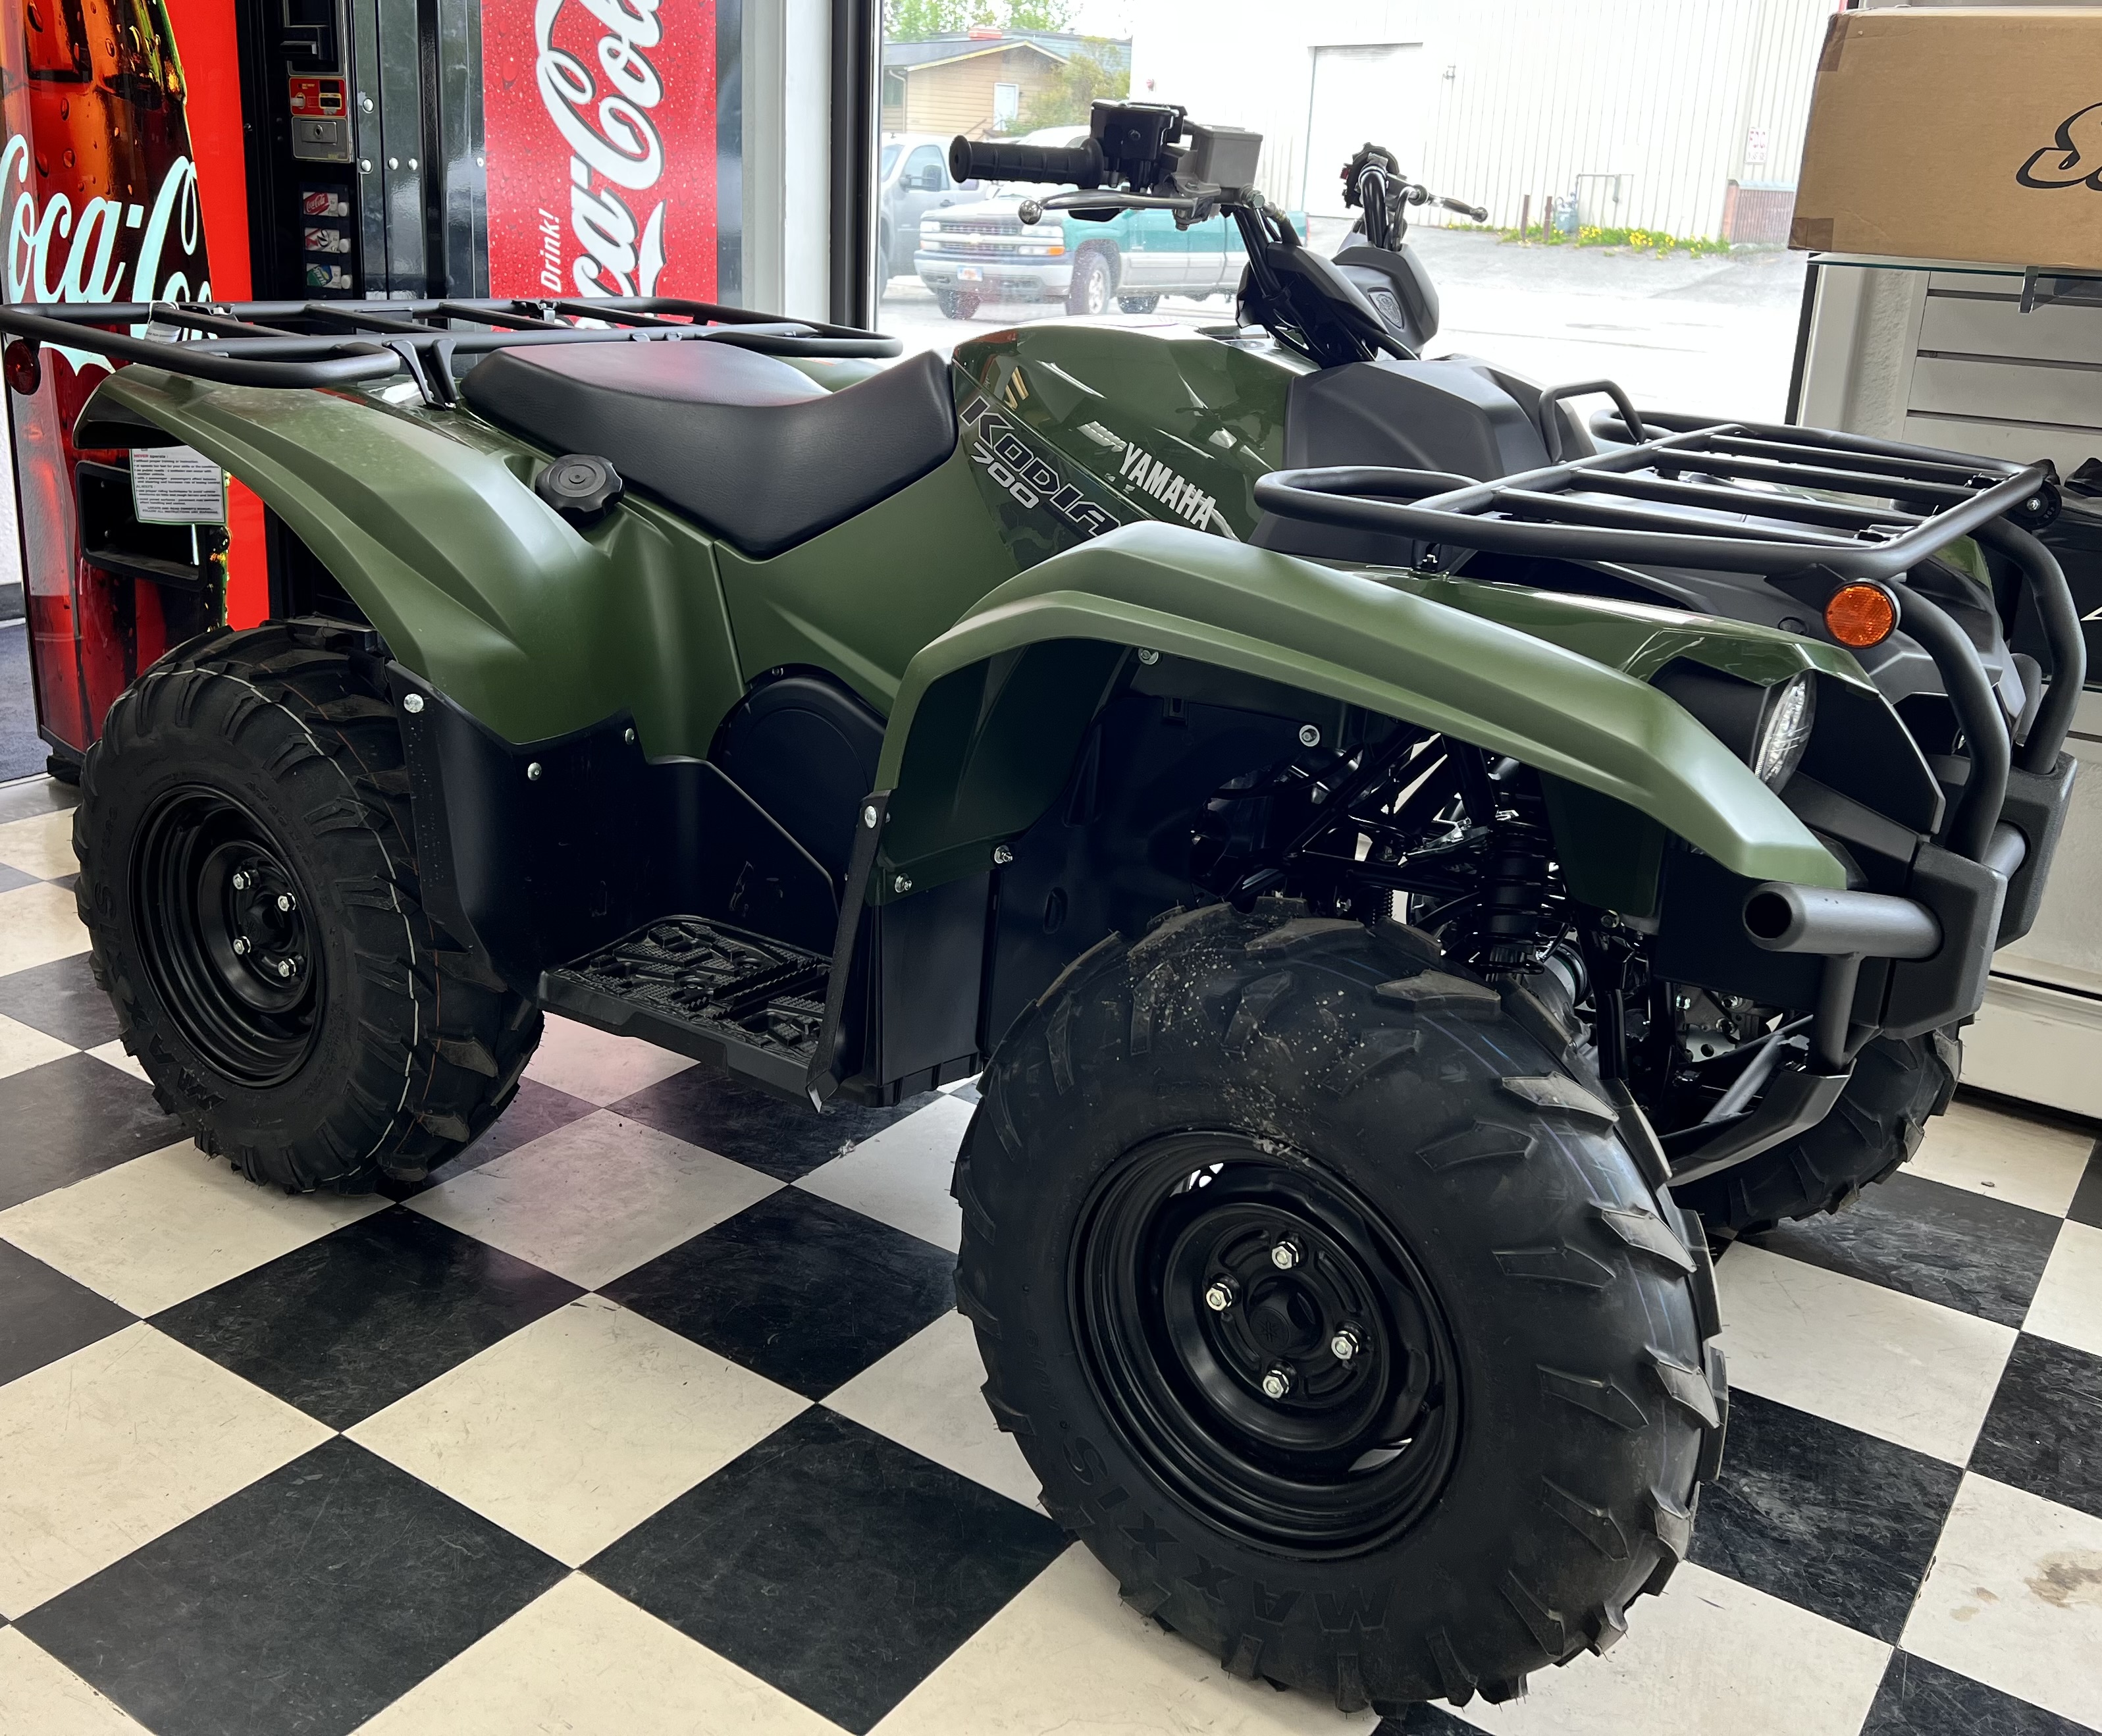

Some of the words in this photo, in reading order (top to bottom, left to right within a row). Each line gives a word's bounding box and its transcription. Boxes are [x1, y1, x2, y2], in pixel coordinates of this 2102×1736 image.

[539, 207, 562, 294] Drink!
[960, 396, 1121, 537] KODIA
[971, 442, 1039, 509] 700
[1119, 442, 1217, 531] YAMAHA
[1062, 1435, 1396, 1633] MAXXIS
